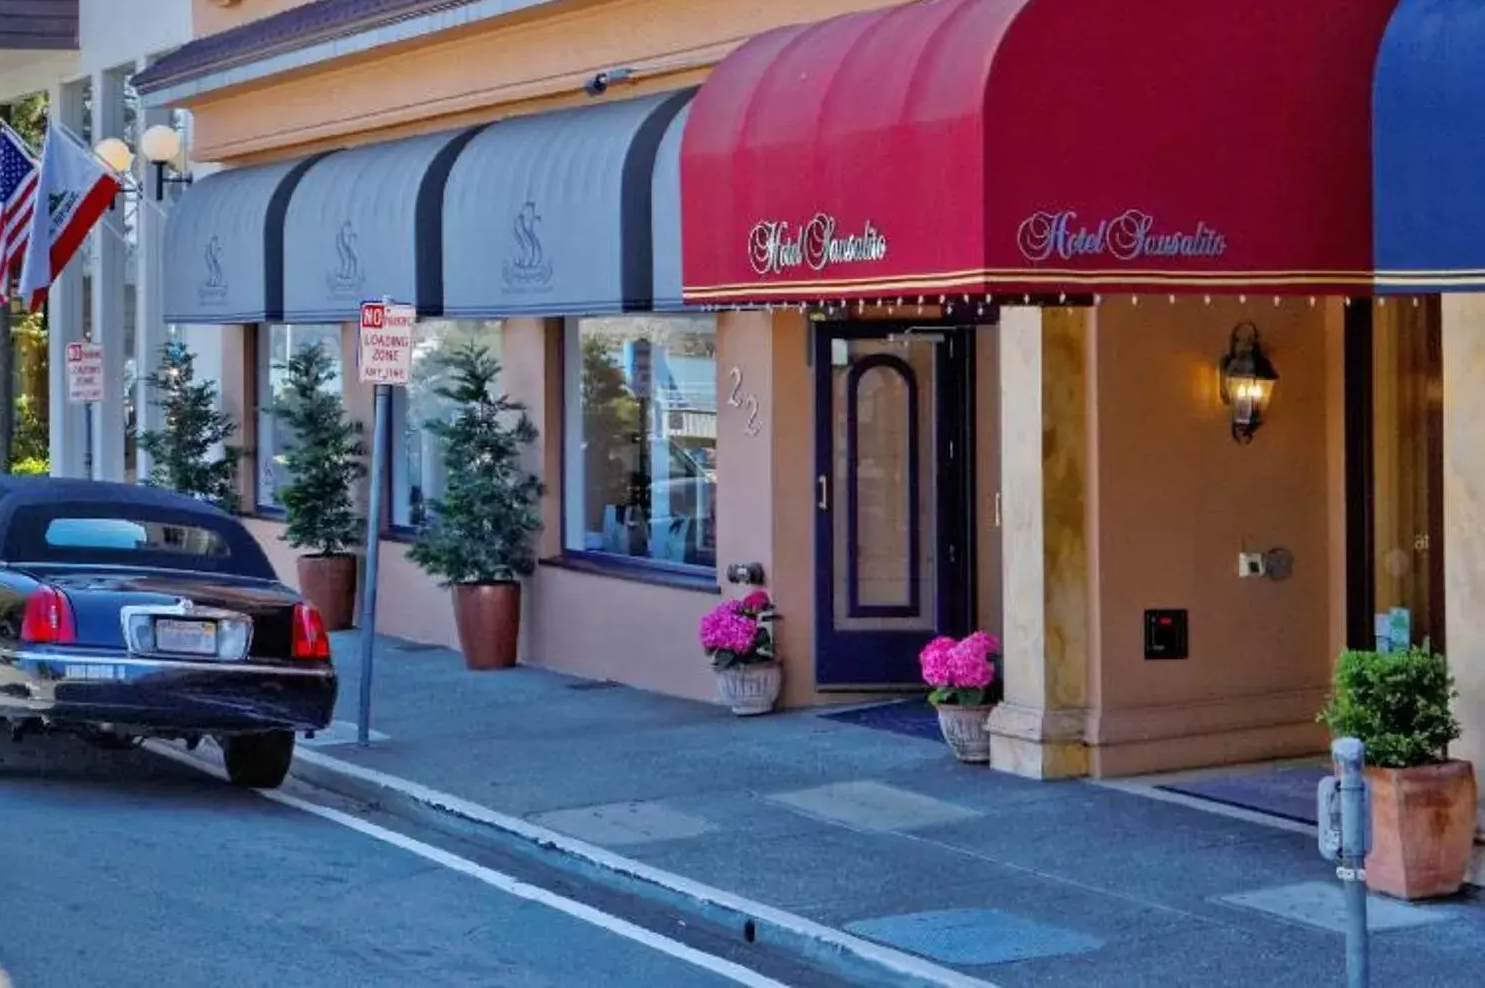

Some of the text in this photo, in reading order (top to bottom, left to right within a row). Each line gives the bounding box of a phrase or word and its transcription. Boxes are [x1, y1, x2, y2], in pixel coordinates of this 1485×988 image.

[748, 212, 887, 274] Hotel Sausalito
[1017, 209, 1227, 260] Hotel Sausalito
[363, 307, 383, 325] NO
[364, 334, 408, 347] LOADING
[372, 349, 399, 361] ZONE
[727, 366, 763, 438] 22
